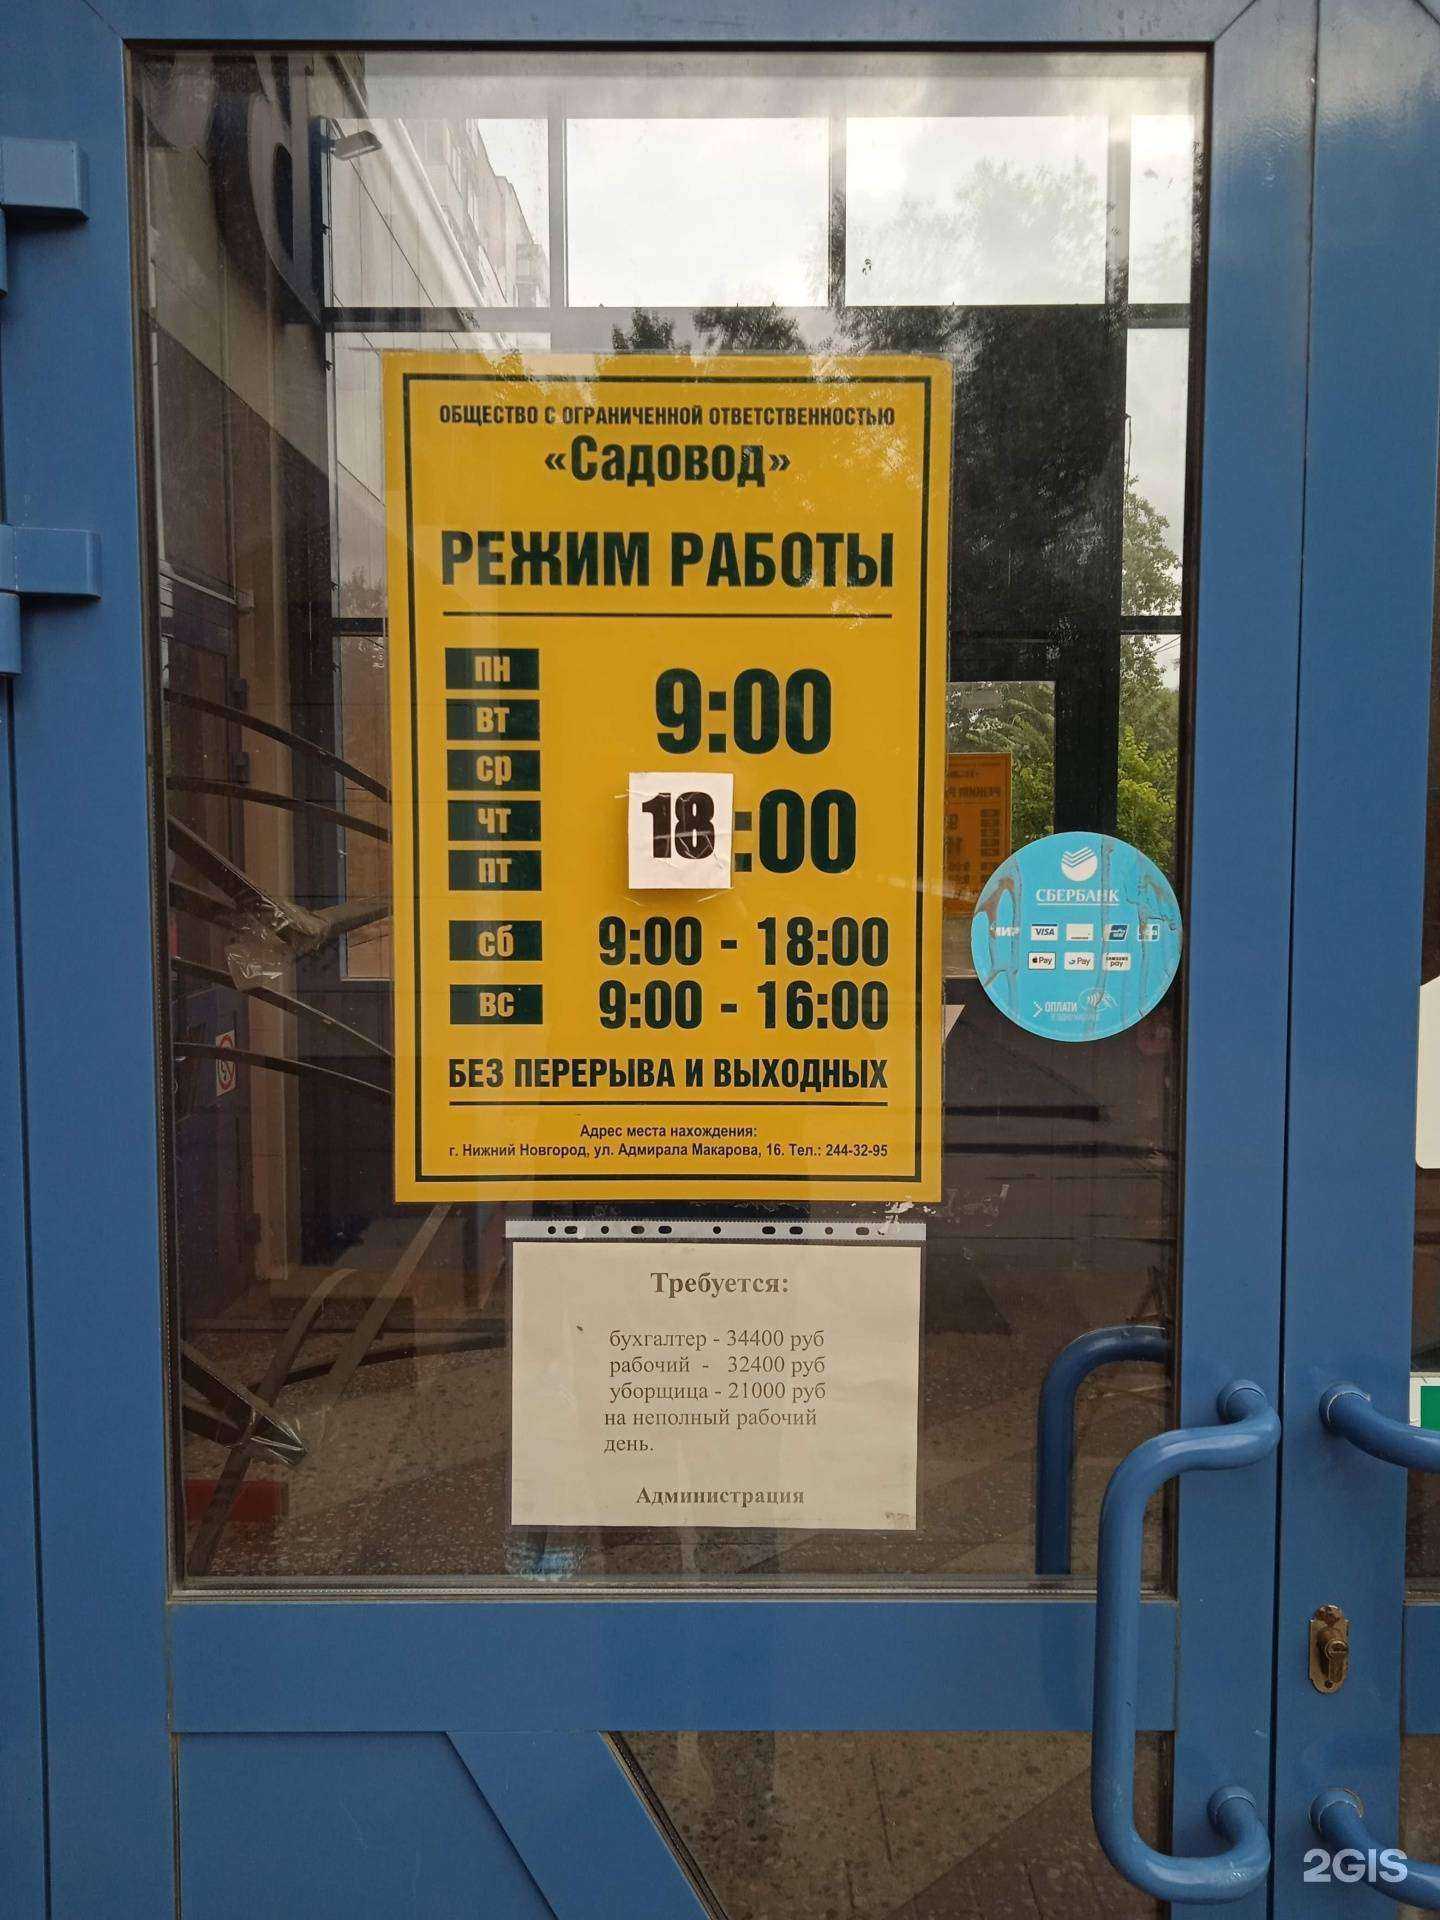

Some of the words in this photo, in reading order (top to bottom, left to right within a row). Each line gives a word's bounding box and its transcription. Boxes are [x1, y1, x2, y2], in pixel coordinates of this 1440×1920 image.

[440, 405, 538, 427] ОБЩЕСТВО
[544, 406, 556, 425] С
[562, 403, 703, 426] ОГРАНИЧЕННОЙ
[709, 406, 896, 427] ОТВЕТСТВЕННОСТЬЮ
[544, 435, 791, 488] «Садовод»
[441, 531, 650, 587] РЕЖИМ
[671, 532, 894, 588] РАБОТЫ
[655, 667, 832, 755] 9:00
[1035, 888, 1120, 903] СБЕРБАНК
[599, 916, 703, 966] 9:00
[757, 917, 889, 967] 18:00
[1034, 927, 1055, 936] VISA
[1038, 955, 1052, 965] Pay
[599, 980, 703, 1029] 9:00
[757, 981, 889, 1031] 16:00
[1045, 1001, 1077, 1012] ОПЛАТИ
[449, 1058, 504, 1088] БЕЗ
[516, 1058, 675, 1088] ПЕРЕРЫВА
[685, 1058, 703, 1088] И
[715, 1058, 888, 1093] ВЫХОДНЫХ
[580, 1124, 622, 1141] Адрес
[626, 1127, 666, 1138] места
[670, 1126, 757, 1140] нахождения:
[449, 1146, 459, 1157] г.
[463, 1143, 516, 1157] Нижний
[520, 1144, 589, 1159] Новгород,
[594, 1146, 613, 1160] ул.
[618, 1143, 687, 1160] Адмирала
[692, 1143, 762, 1159] Макарова,
[766, 1143, 784, 1157] 16.
[789, 1143, 821, 1157] Тел.:
[826, 1143, 888, 1157] 244-32-95
[651, 1271, 789, 1298] Требуется:
[609, 1330, 707, 1352] бухгалтер
[726, 1330, 784, 1347] 34400
[790, 1330, 824, 1352] руб
[609, 1355, 690, 1377] рабочий
[728, 1355, 785, 1373] 32400
[791, 1355, 825, 1378] руб
[609, 1382, 708, 1404] уборщица
[728, 1382, 786, 1400] 21000
[792, 1382, 826, 1404] руб
[605, 1412, 626, 1426] на
[632, 1408, 730, 1426] неполный
[736, 1407, 817, 1430] рабочий
[603, 1436, 654, 1454] день.
[636, 1487, 804, 1508] Администрация
